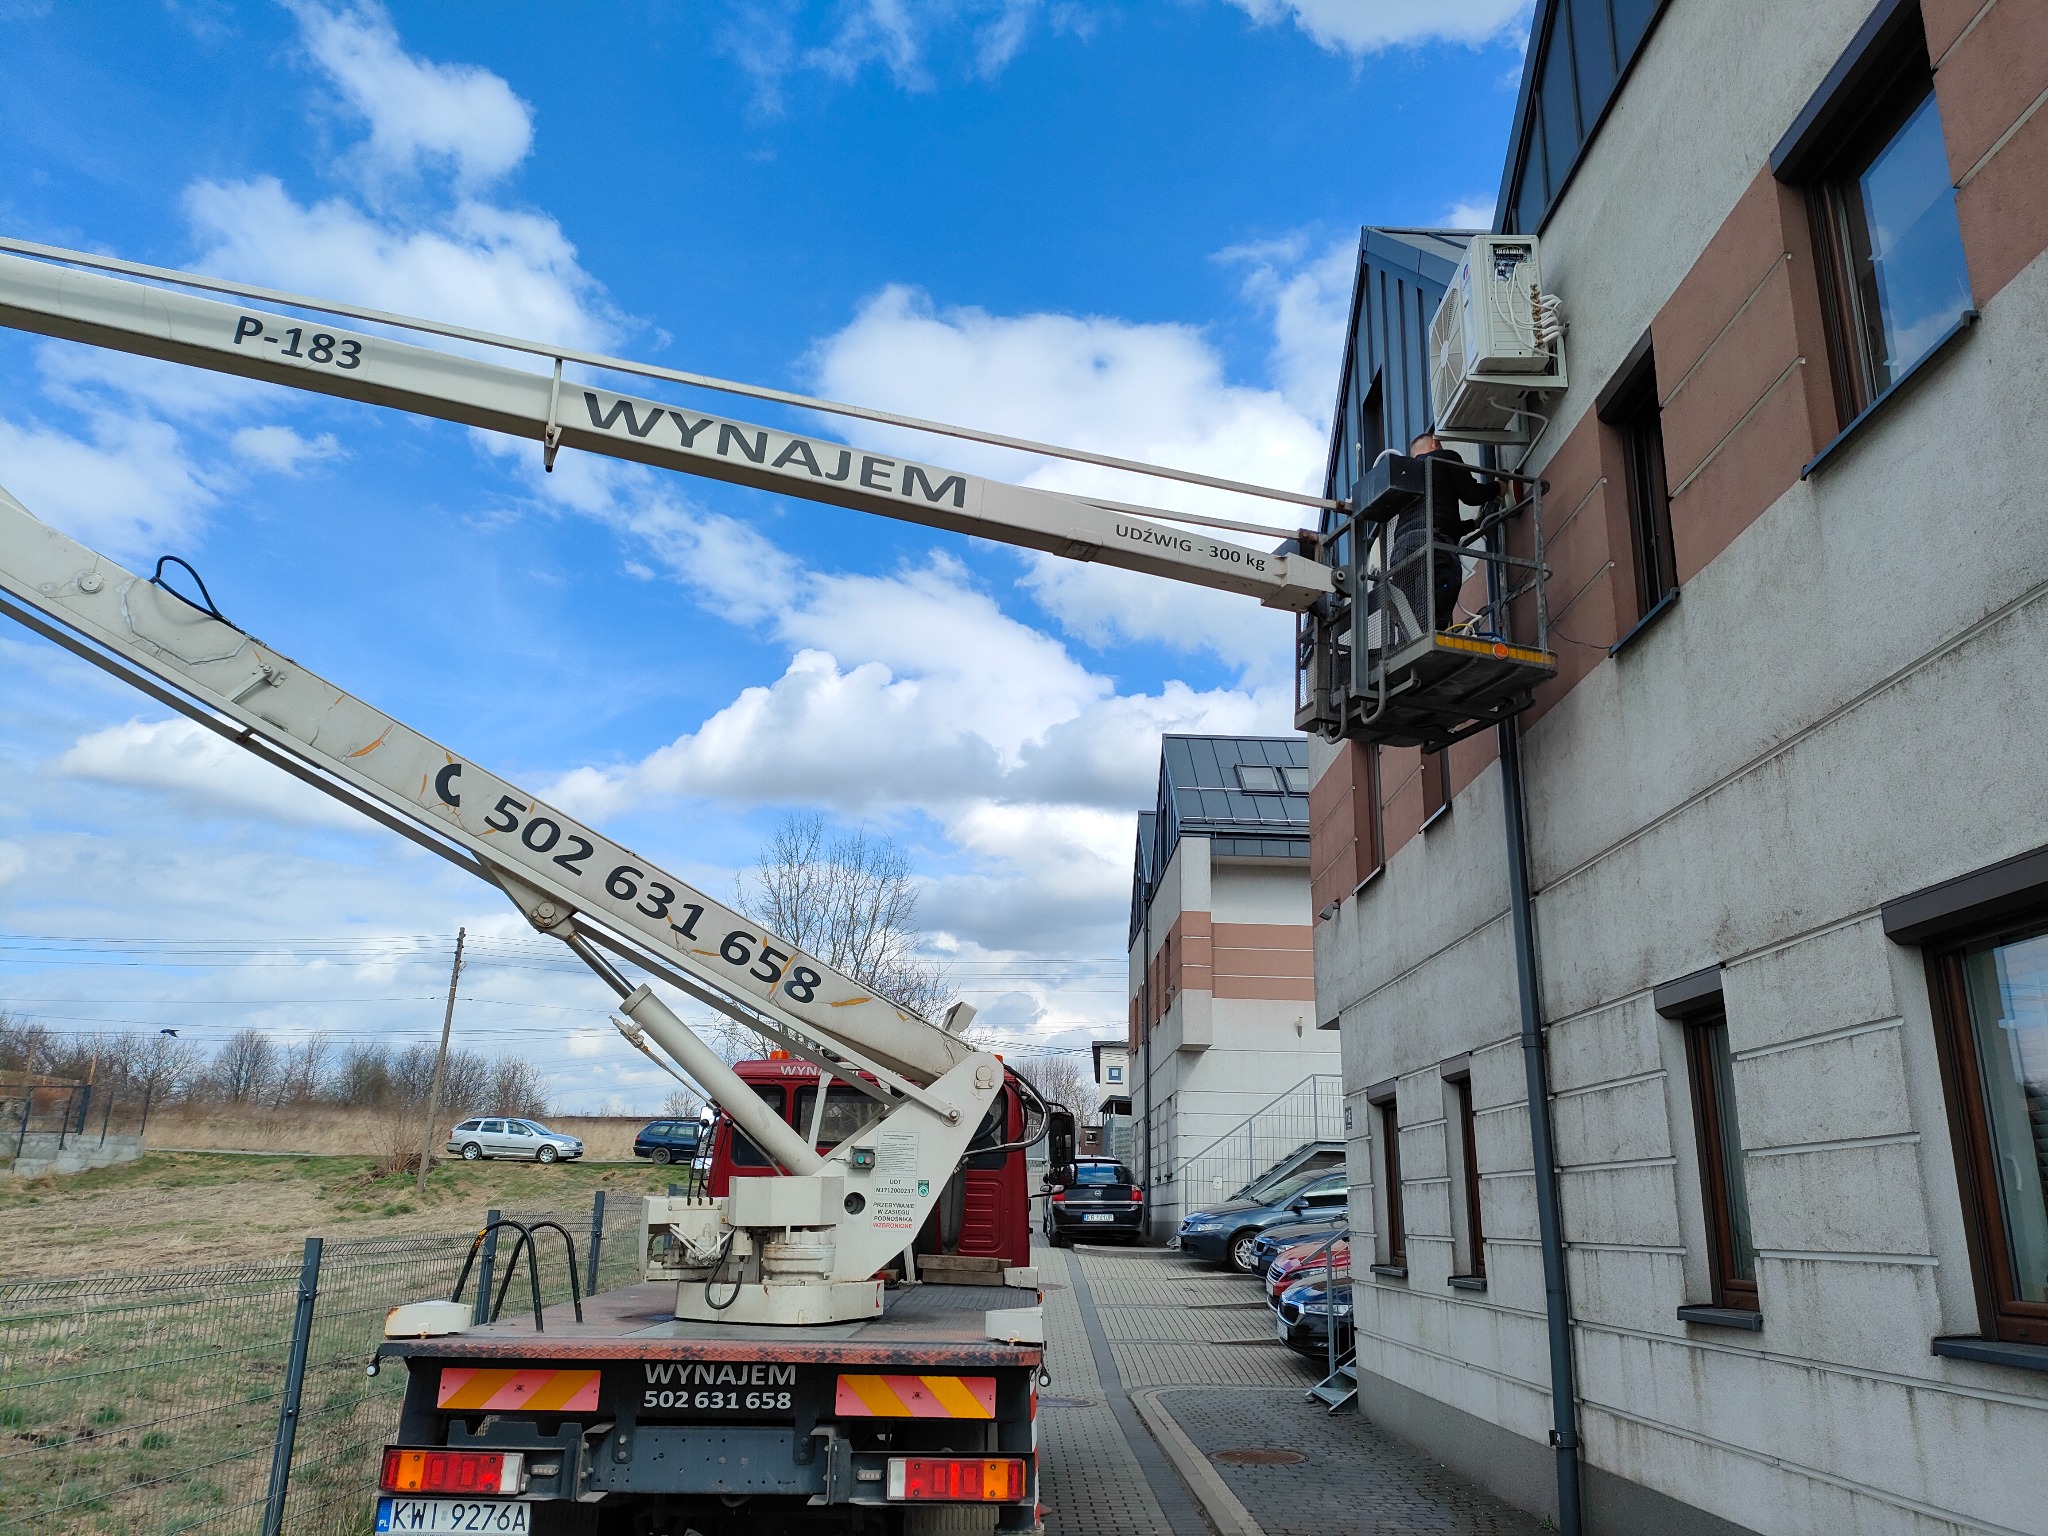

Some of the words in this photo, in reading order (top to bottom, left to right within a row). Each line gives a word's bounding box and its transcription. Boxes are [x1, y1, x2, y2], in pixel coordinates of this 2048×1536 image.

[233, 315, 362, 370] P-183
[583, 391, 967, 509] WYNAJEM
[1116, 524, 1192, 552] UDŹWIG
[1208, 545, 1241, 563] 300
[1246, 553, 1266, 572] kg
[484, 795, 594, 876] 502
[605, 865, 705, 941] 631
[720, 930, 821, 1003] 658
[644, 1363, 796, 1386] WYNAJEM
[643, 1390, 689, 1408] 502
[694, 1391, 739, 1409] 631
[745, 1392, 791, 1410] 658
[378, 1519, 388, 1527] PL
[450, 1503, 526, 1532] 9276A
